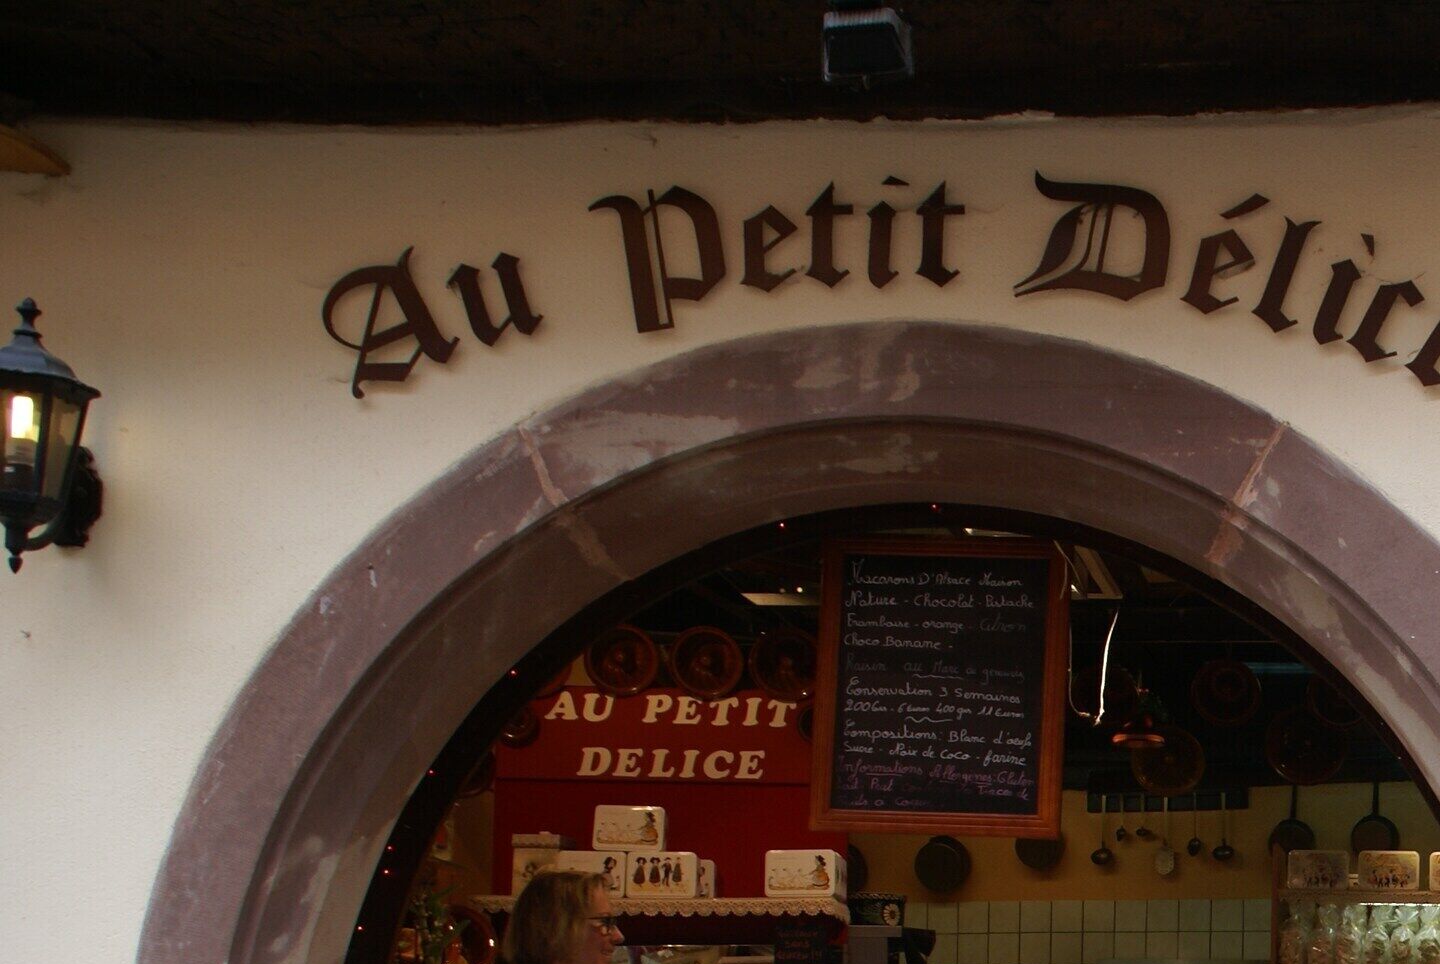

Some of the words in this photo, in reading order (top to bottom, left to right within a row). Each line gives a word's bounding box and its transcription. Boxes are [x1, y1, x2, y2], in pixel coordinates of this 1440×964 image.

[321, 245, 543, 400] Au
[588, 176, 966, 334] Petit
[914, 595, 975, 609] Chocolat
[544, 690, 615, 723] AU
[642, 693, 797, 729] PETIT
[576, 747, 766, 780] DELICE
